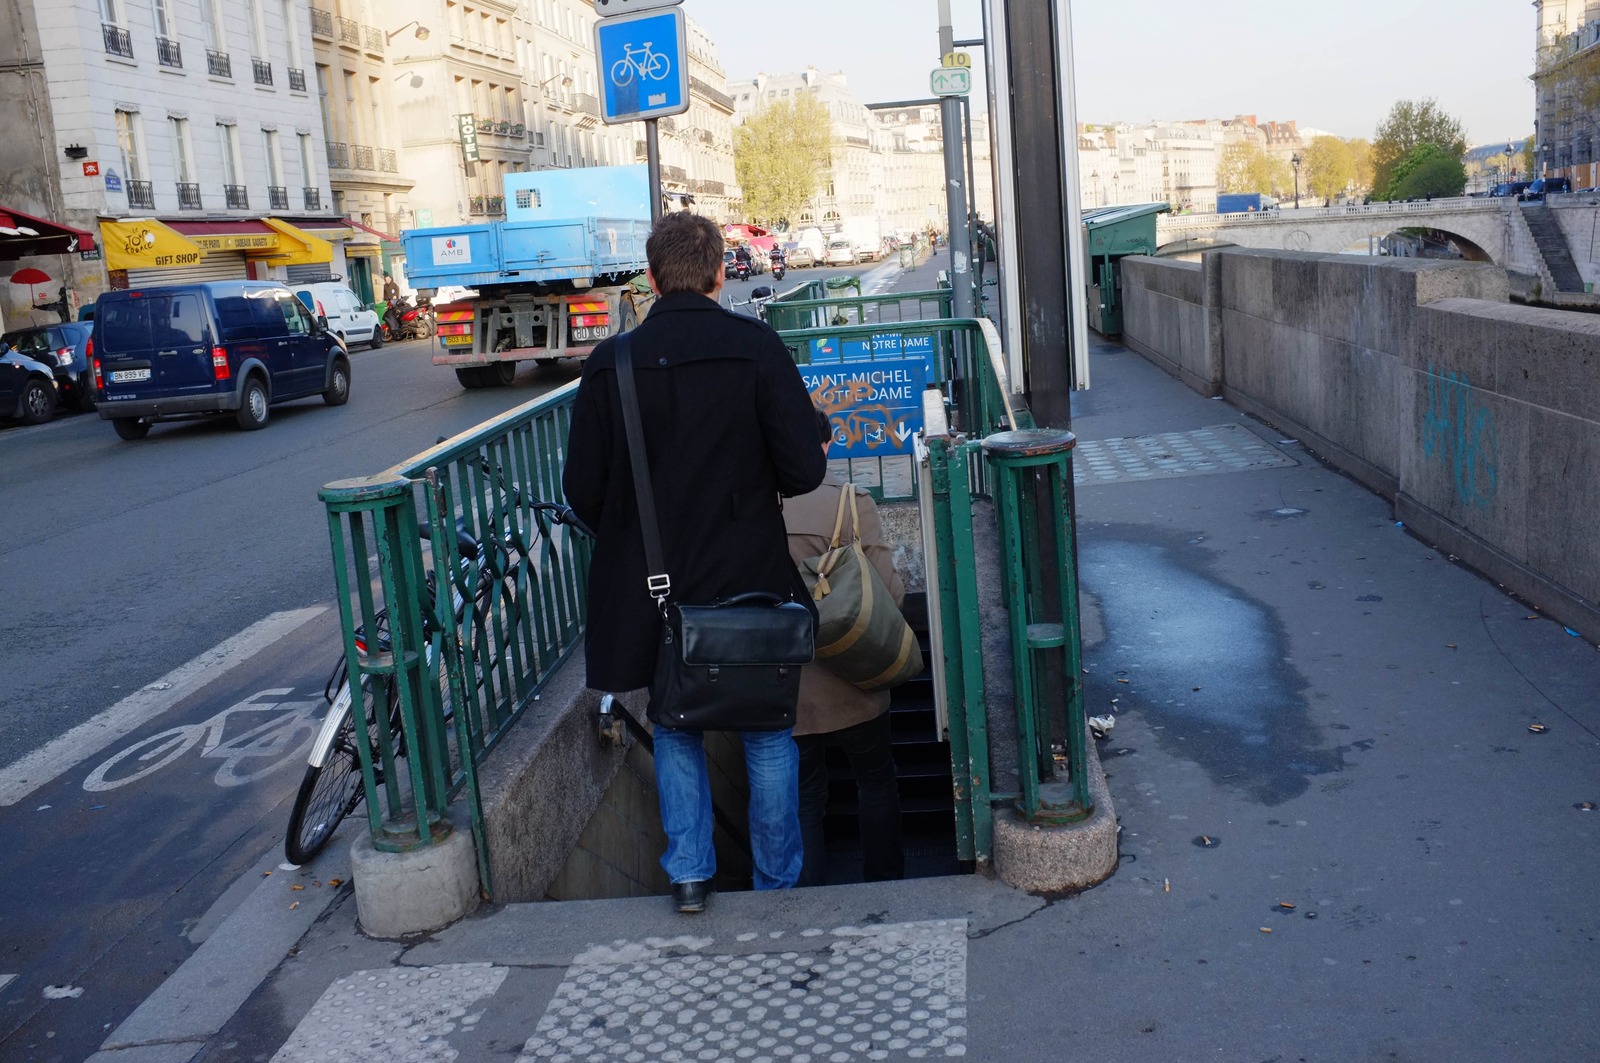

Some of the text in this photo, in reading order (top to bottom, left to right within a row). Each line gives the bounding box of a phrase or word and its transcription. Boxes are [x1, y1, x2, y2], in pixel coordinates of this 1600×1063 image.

[948, 53, 966, 66] 10
[461, 115, 478, 162] HOTEL
[155, 252, 199, 266] GIFT SHOP
[440, 248, 464, 257] AMB
[575, 326, 606, 339] 80 90
[862, 336, 930, 351] NOTRE DAME
[137, 369, 147, 378] VE
[802, 369, 912, 389] SAINT-MICHEL
[868, 385, 913, 401] DAME
